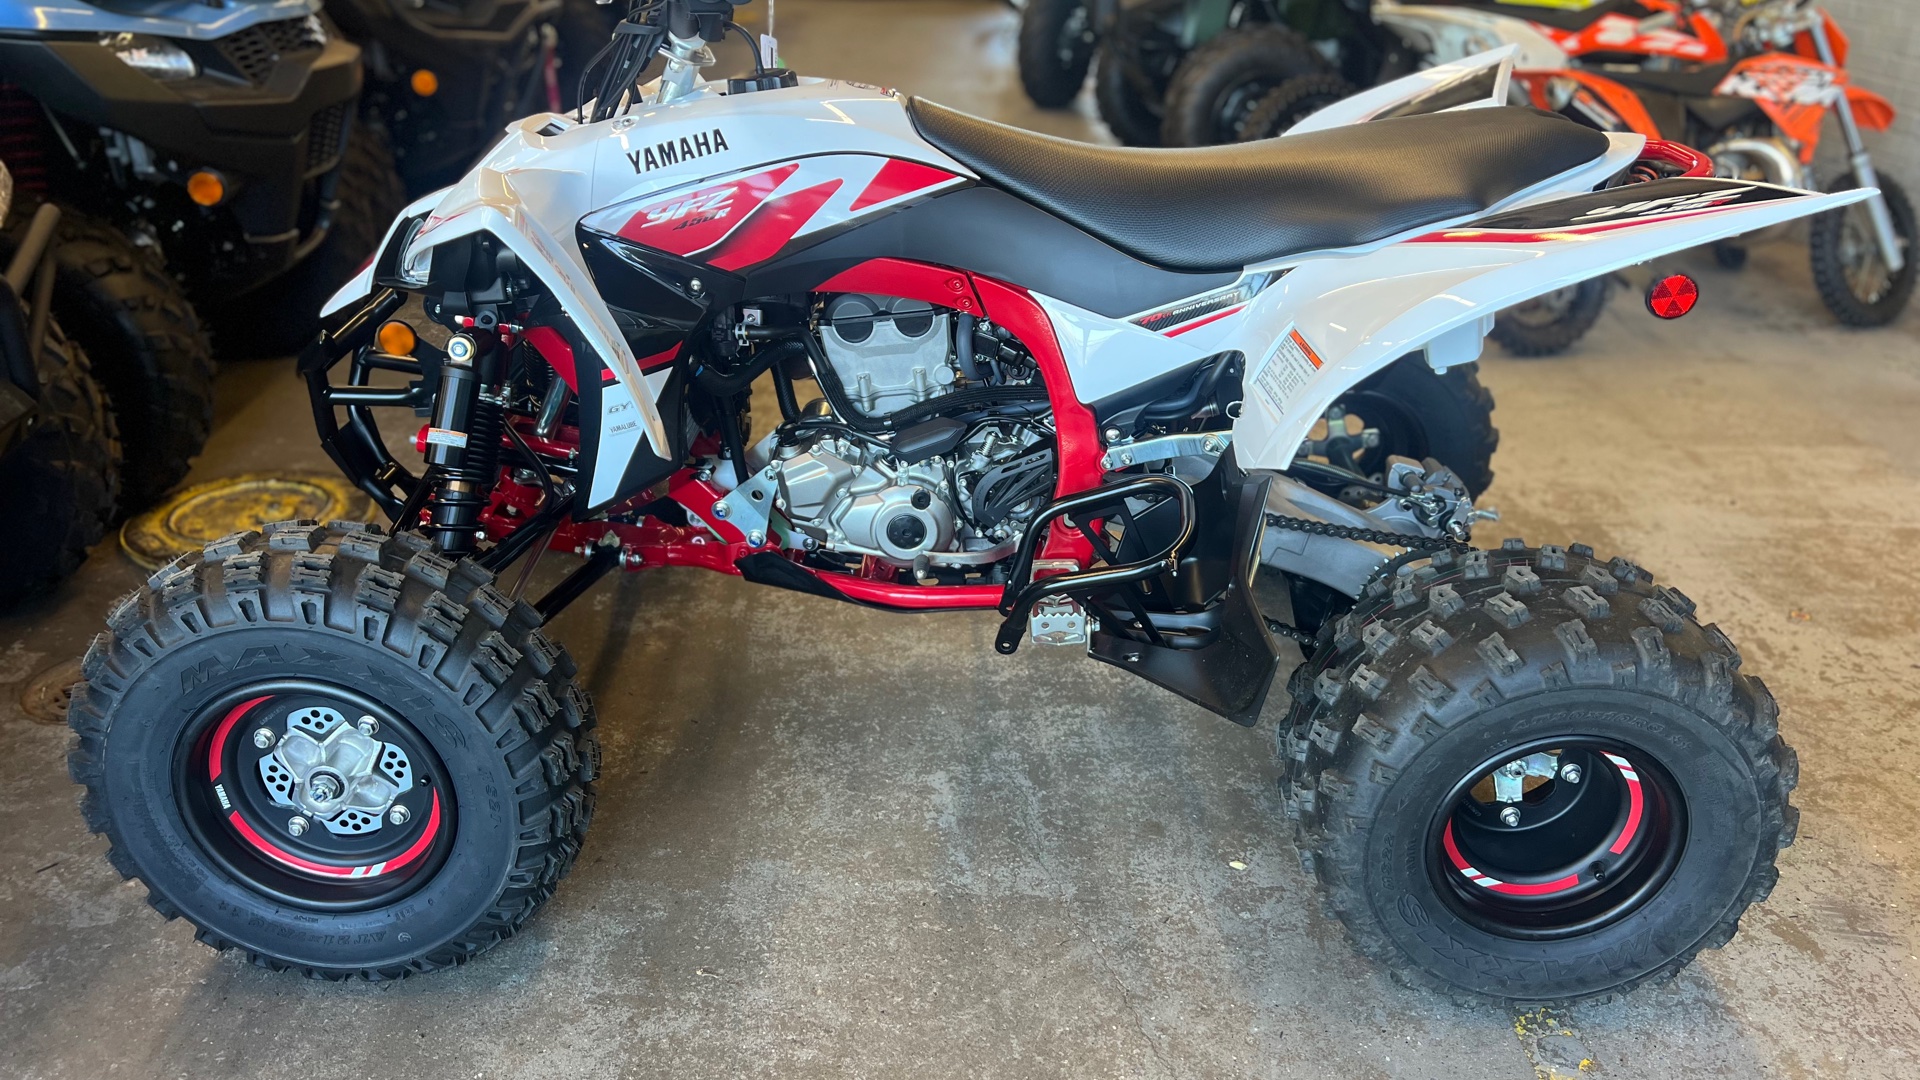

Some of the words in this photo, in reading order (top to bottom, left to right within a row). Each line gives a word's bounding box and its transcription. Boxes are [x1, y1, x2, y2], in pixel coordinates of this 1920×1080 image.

[626, 128, 729, 175] YAMAHA
[641, 186, 738, 228] YFZ
[672, 207, 731, 231] 450R
[1172, 291, 1239, 316] ANNIVERSARY
[609, 421, 637, 433] YAMALUBE
[181, 643, 466, 749] MAXXIS
[214, 783, 231, 810] YAMAHA
[1397, 891, 1652, 982] MAXXIS
